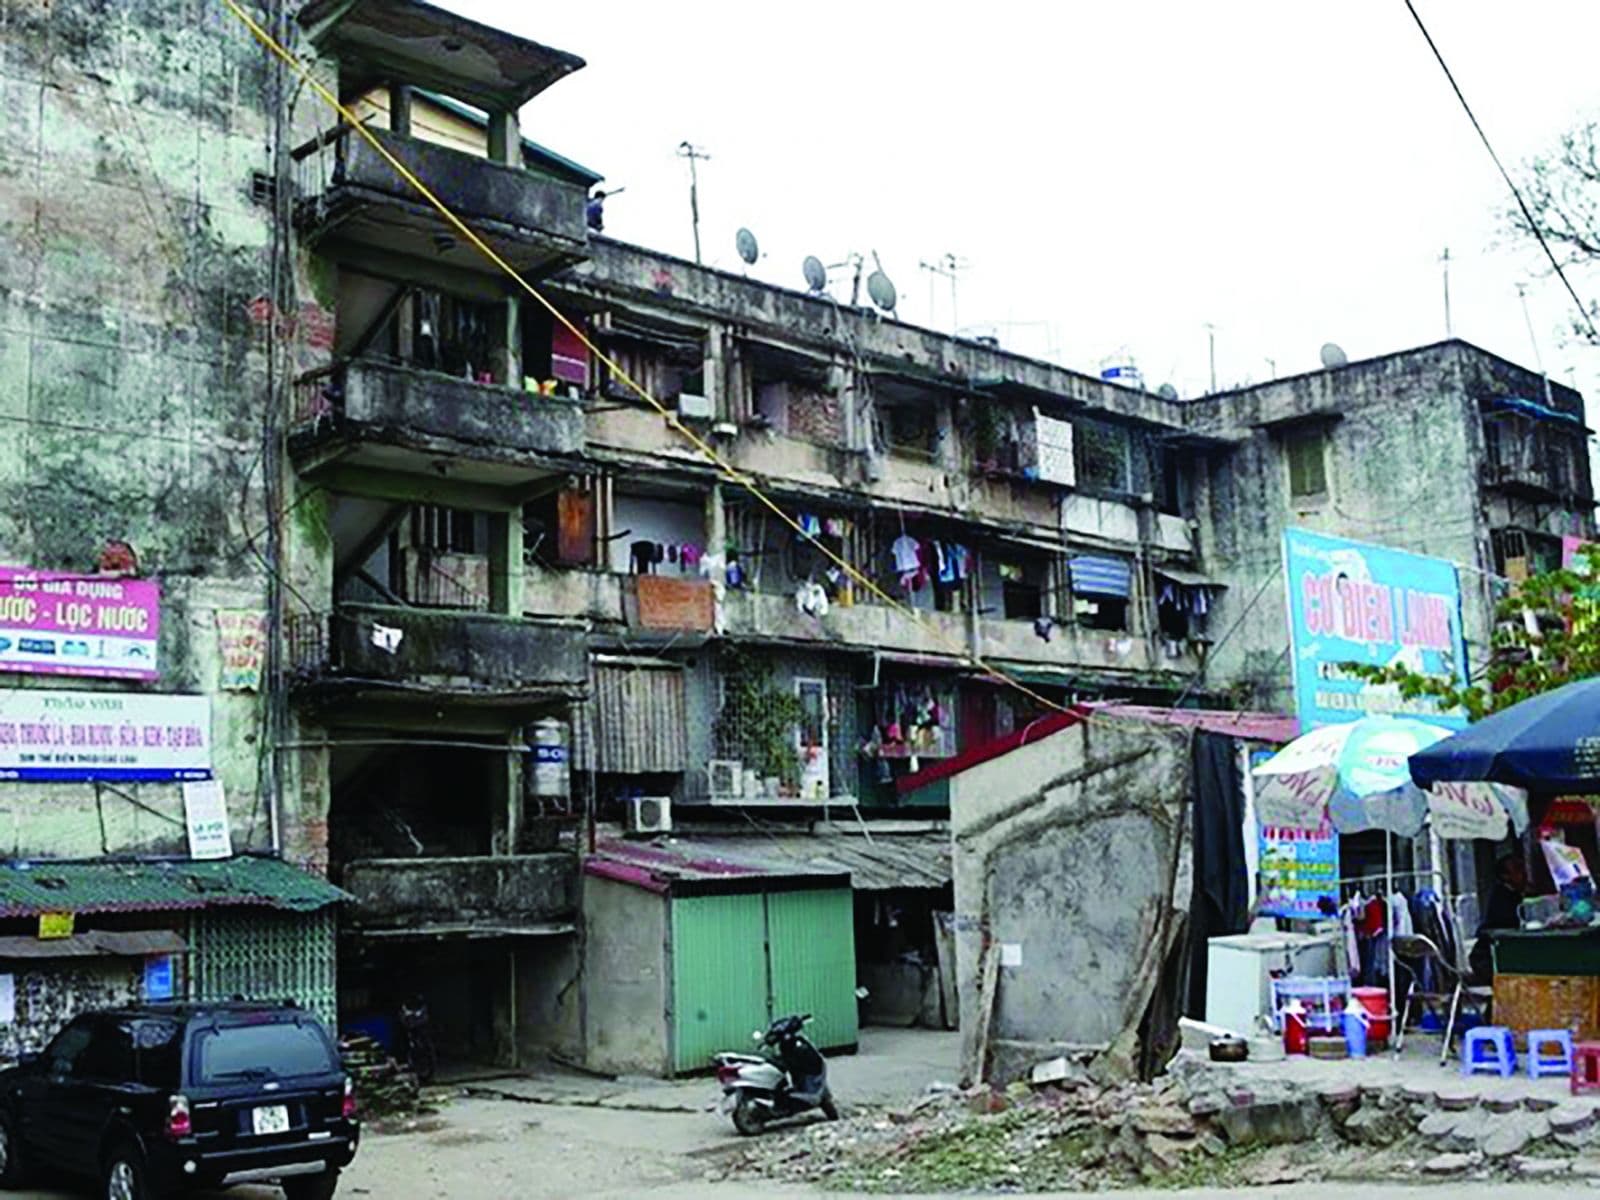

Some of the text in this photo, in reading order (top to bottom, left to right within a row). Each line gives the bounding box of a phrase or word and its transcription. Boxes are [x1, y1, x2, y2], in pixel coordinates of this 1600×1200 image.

[42, 580, 72, 596] GIA
[76, 581, 124, 600] DỤNG
[56, 603, 92, 632] LỌC
[97, 601, 149, 632] NƯỚC
